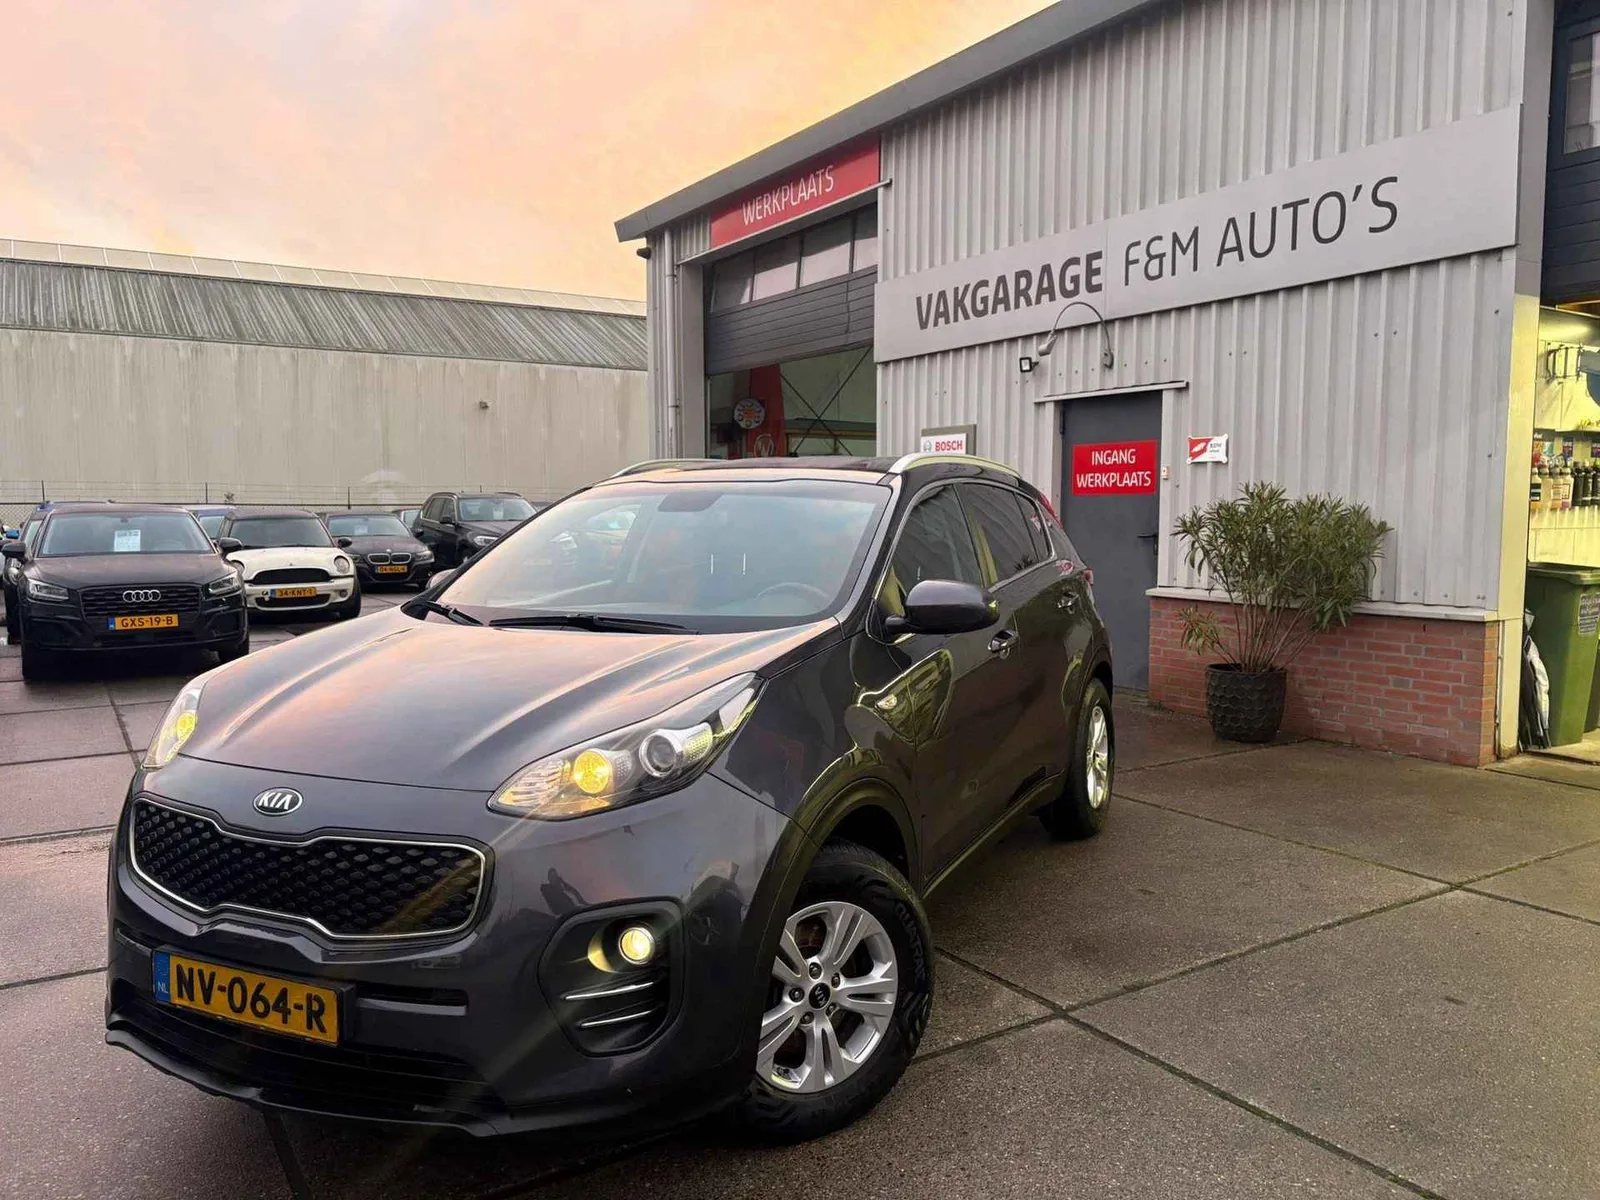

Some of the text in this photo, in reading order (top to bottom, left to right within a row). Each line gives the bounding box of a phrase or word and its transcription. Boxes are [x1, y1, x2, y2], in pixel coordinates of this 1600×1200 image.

[742, 164, 834, 226] WERKPLAATS
[915, 176, 1399, 330] VAKGARAGE F&M AUTO'S
[934, 439, 963, 453] BOSCH
[1091, 448, 1136, 466] INGANG
[1076, 470, 1152, 489] WERKPLAATS
[121, 616, 173, 628] GXS-19-B
[258, 791, 293, 811] KIA
[157, 963, 327, 1034] NL NV-064-R
